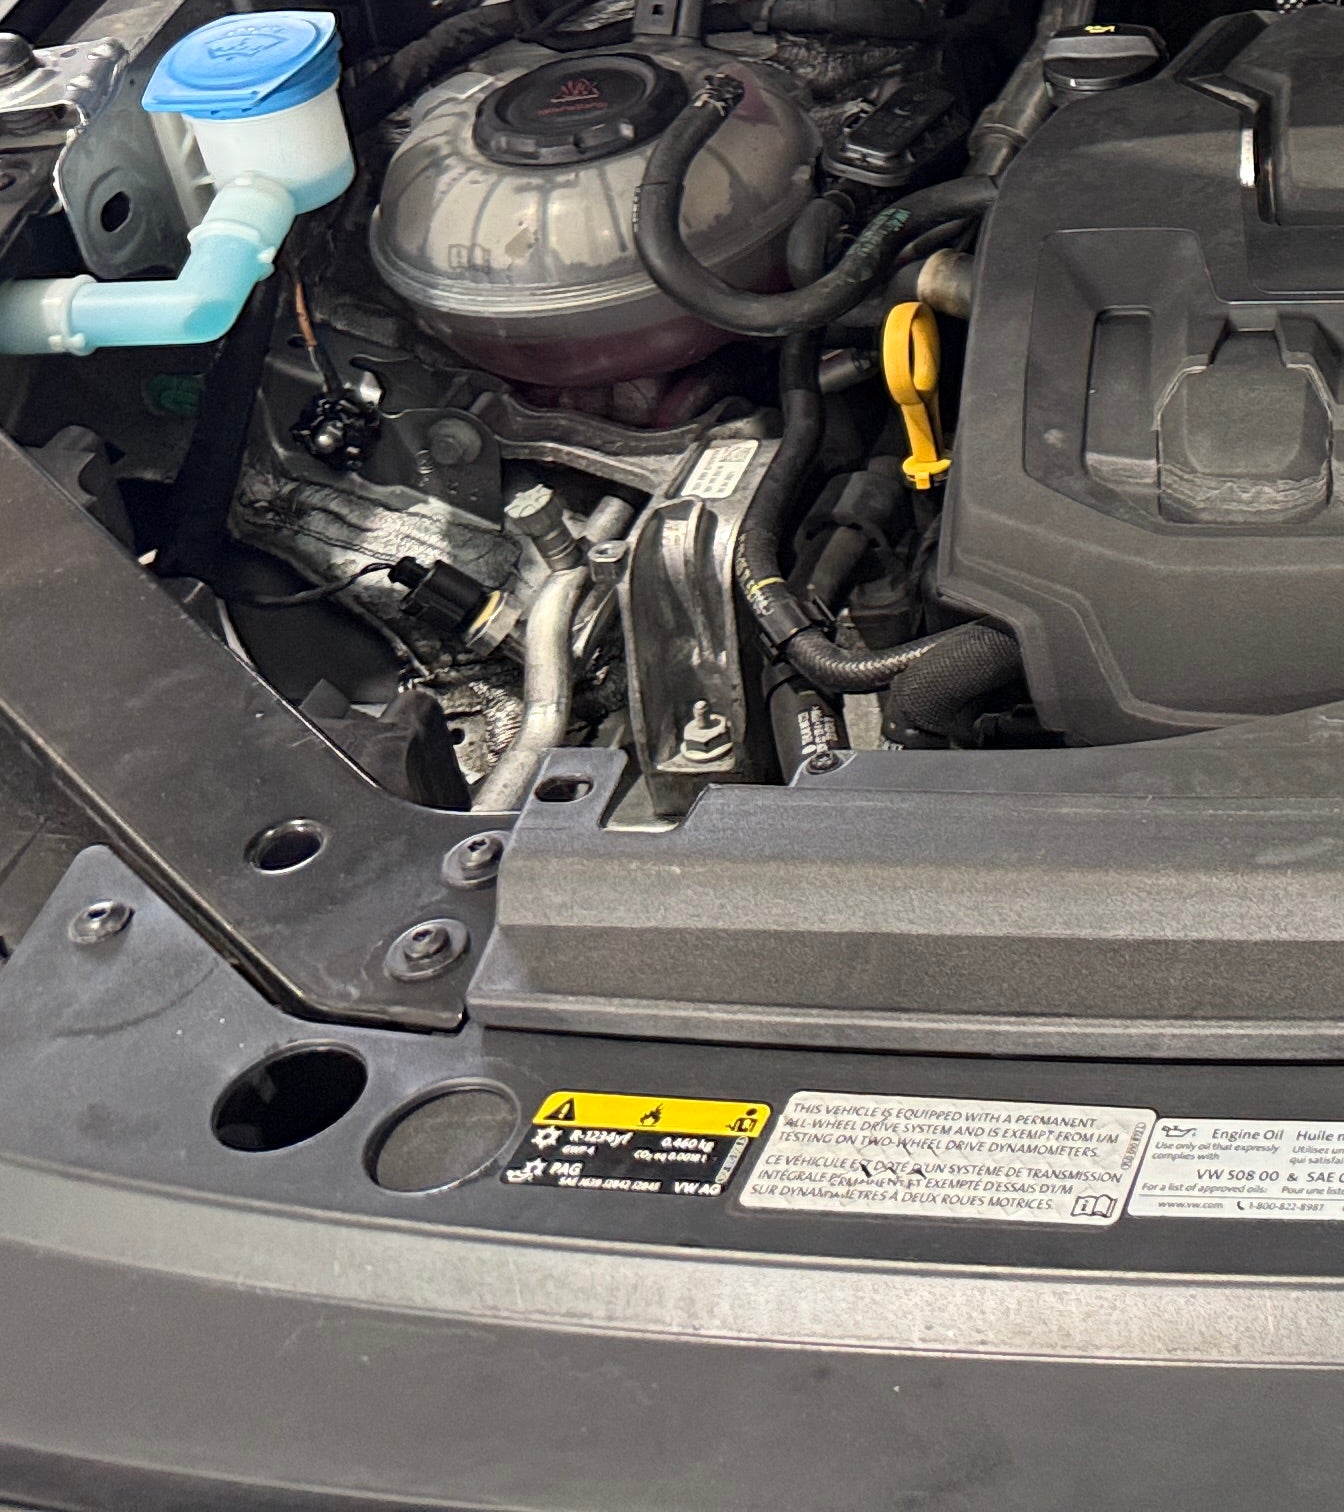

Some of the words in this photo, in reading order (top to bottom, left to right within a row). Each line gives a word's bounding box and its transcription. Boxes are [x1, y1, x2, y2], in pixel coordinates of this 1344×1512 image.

[794, 1102, 821, 1114] THIS
[826, 1104, 877, 1117] VEHICLE
[881, 1108, 893, 1117] IS
[896, 1107, 962, 1122] EQUIPPED
[965, 1111, 1001, 1123] WITH
[1002, 1114, 1012, 1123] A
[1015, 1114, 1098, 1128] PERMANENT
[784, 1118, 857, 1131] ALL-WHEEL
[860, 1120, 899, 1132] DRIVE
[902, 1122, 951, 1134] SYSTEM
[954, 1126, 985, 1137] AND
[988, 1128, 999, 1137] IS
[1002, 1128, 1054, 1140] EXEMPT
[1057, 1131, 1094, 1142] FROM
[1096, 1133, 1119, 1144] I/M
[1212, 1129, 1260, 1142] Engine
[1263, 1129, 1284, 1140] Oil
[1296, 1130, 1335, 1142] Huile
[569, 1130, 635, 1148] R-1234yf
[661, 1136, 697, 1150] 0.460
[699, 1138, 716, 1153] kg
[779, 1132, 833, 1144] TESTING
[835, 1134, 856, 1145] ON
[860, 1136, 942, 1150] TWO-WHEEL
[945, 1140, 986, 1151] DRIVE
[1155, 1142, 1174, 1150] Use
[1176, 1142, 1196, 1152] only
[1199, 1142, 1211, 1151] oil
[1212, 1142, 1233, 1151] that
[1235, 1143, 1280, 1154] expressly
[1152, 1151, 1195, 1161] complies
[1198, 1152, 1220, 1160] with
[1292, 1145, 1329, 1155] Utilisez
[1289, 1156, 1307, 1165] qui
[549, 1161, 583, 1176] PAG
[765, 1155, 784, 1165] CE
[785, 1154, 848, 1168] VÉHICULE
[1005, 1167, 1023, 1178] DE
[1025, 1168, 1123, 1183] TRANSMISSION
[1196, 1168, 1224, 1180] VW
[1227, 1169, 1255, 1181] 508
[1258, 1170, 1280, 1182] 00
[1287, 1172, 1298, 1182] &
[1306, 1172, 1336, 1183] SAE
[758, 1168, 826, 1182] INTÉGRALE
[925, 1176, 982, 1190] EXEMPTÉ
[673, 1181, 699, 1194] VW
[699, 1183, 722, 1196] AG
[751, 1184, 778, 1195] SUR
[901, 1191, 939, 1204] DEUX
[941, 1194, 989, 1206] ROUES
[1142, 1183, 1159, 1191] For
[1168, 1183, 1184, 1192] list
[1185, 1183, 1198, 1192] of
[1198, 1184, 1245, 1195] approved
[1282, 1186, 1304, 1194] Pour
[1158, 1201, 1223, 1209] www.vw.com
